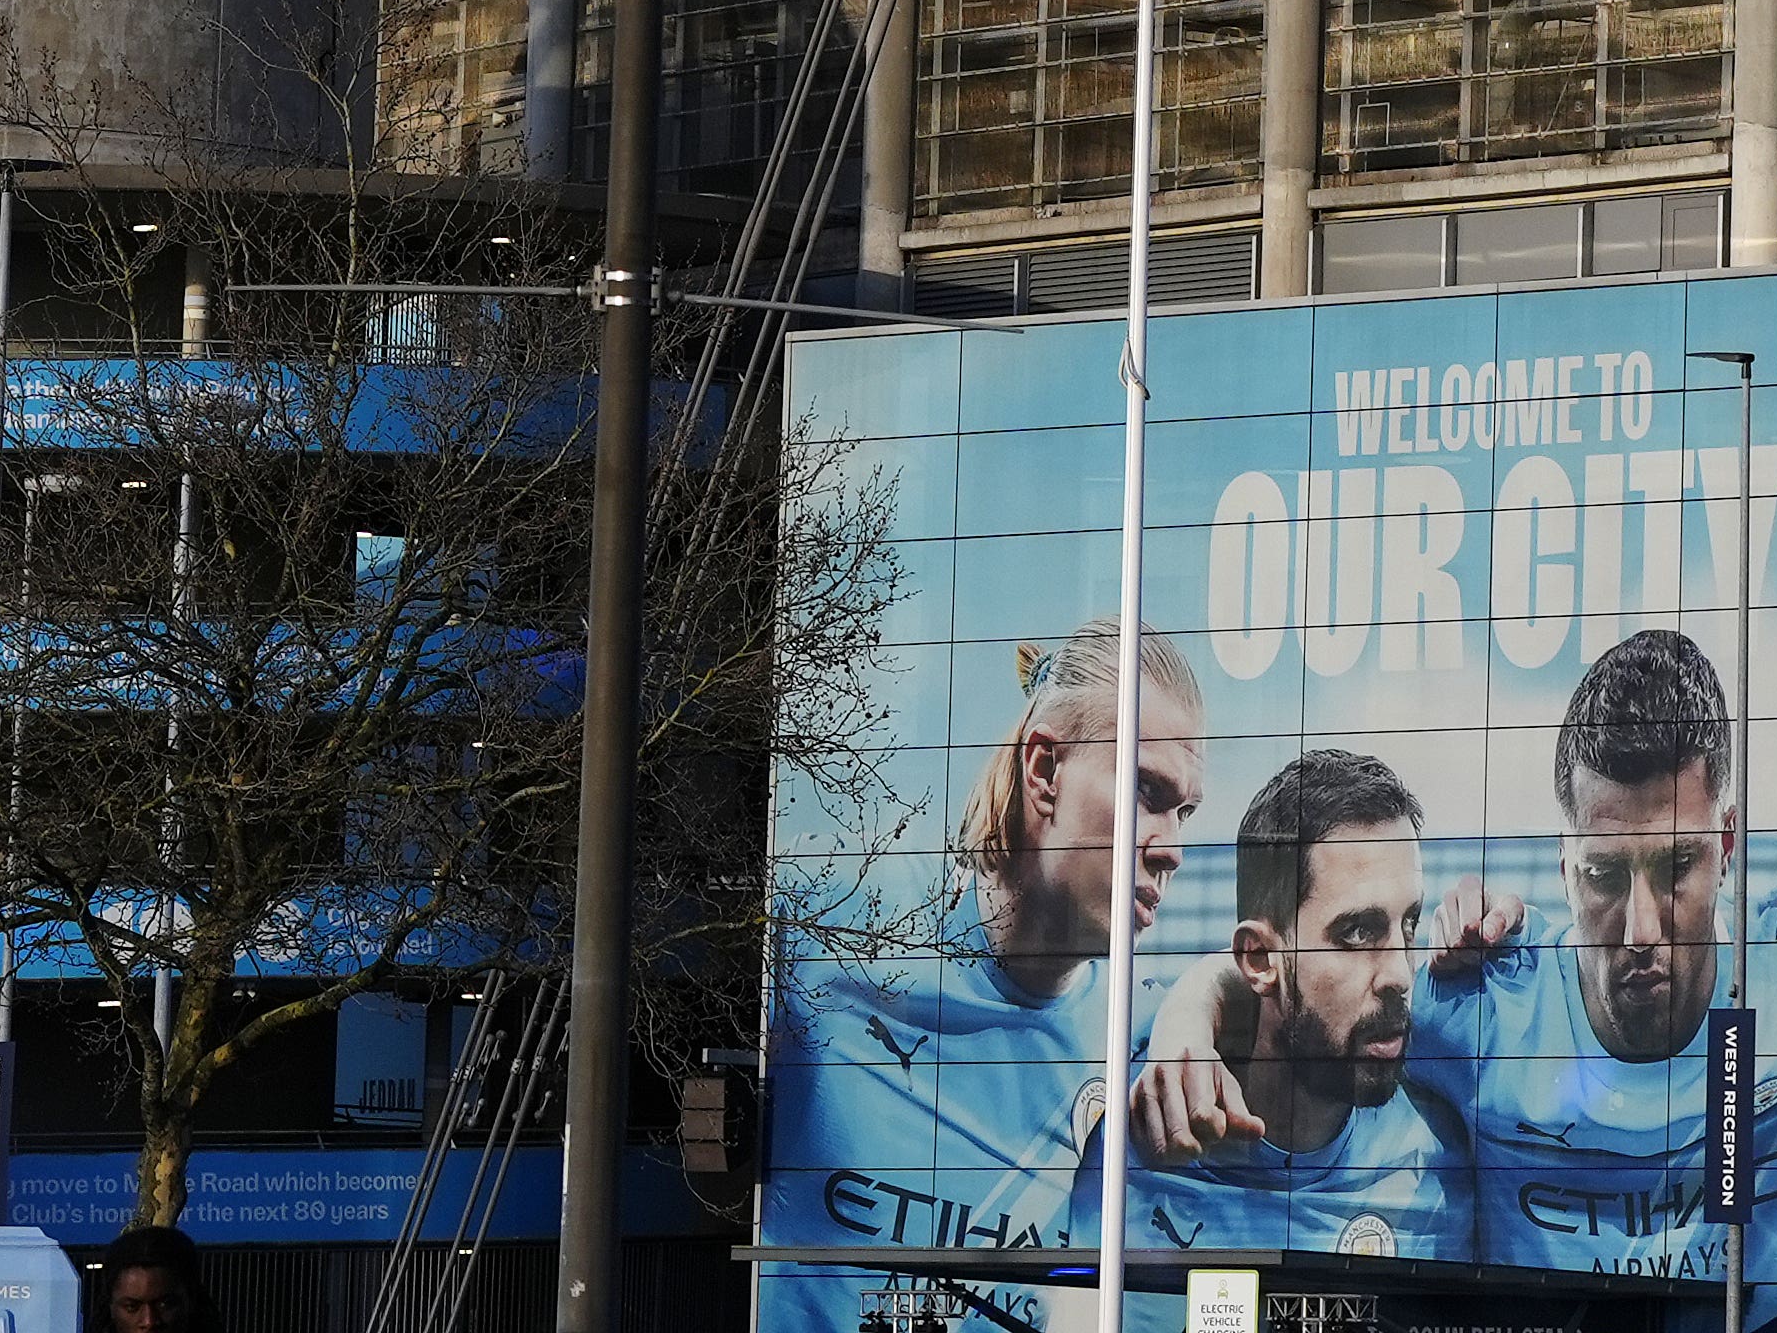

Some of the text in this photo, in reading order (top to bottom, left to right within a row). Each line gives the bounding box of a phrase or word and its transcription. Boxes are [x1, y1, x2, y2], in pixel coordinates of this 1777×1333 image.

[1335, 350, 1653, 457] WELCOME TO
[1208, 464, 1466, 681] OUR
[1724, 1026, 1738, 1085] WEST
[1721, 1090, 1737, 1206] RECEPTION
[25, 1178, 88, 1194] move
[94, 1175, 118, 1194] to
[201, 1172, 259, 1193] Road
[265, 1170, 332, 1192] which
[12, 1203, 84, 1224] Club's
[197, 1202, 233, 1222] the
[239, 1203, 287, 1222] next
[294, 1200, 324, 1222] 80
[330, 1203, 390, 1225] years
[1200, 1304, 1245, 1315] ELECTRIC
[1202, 1317, 1242, 1327] VEHICLE
